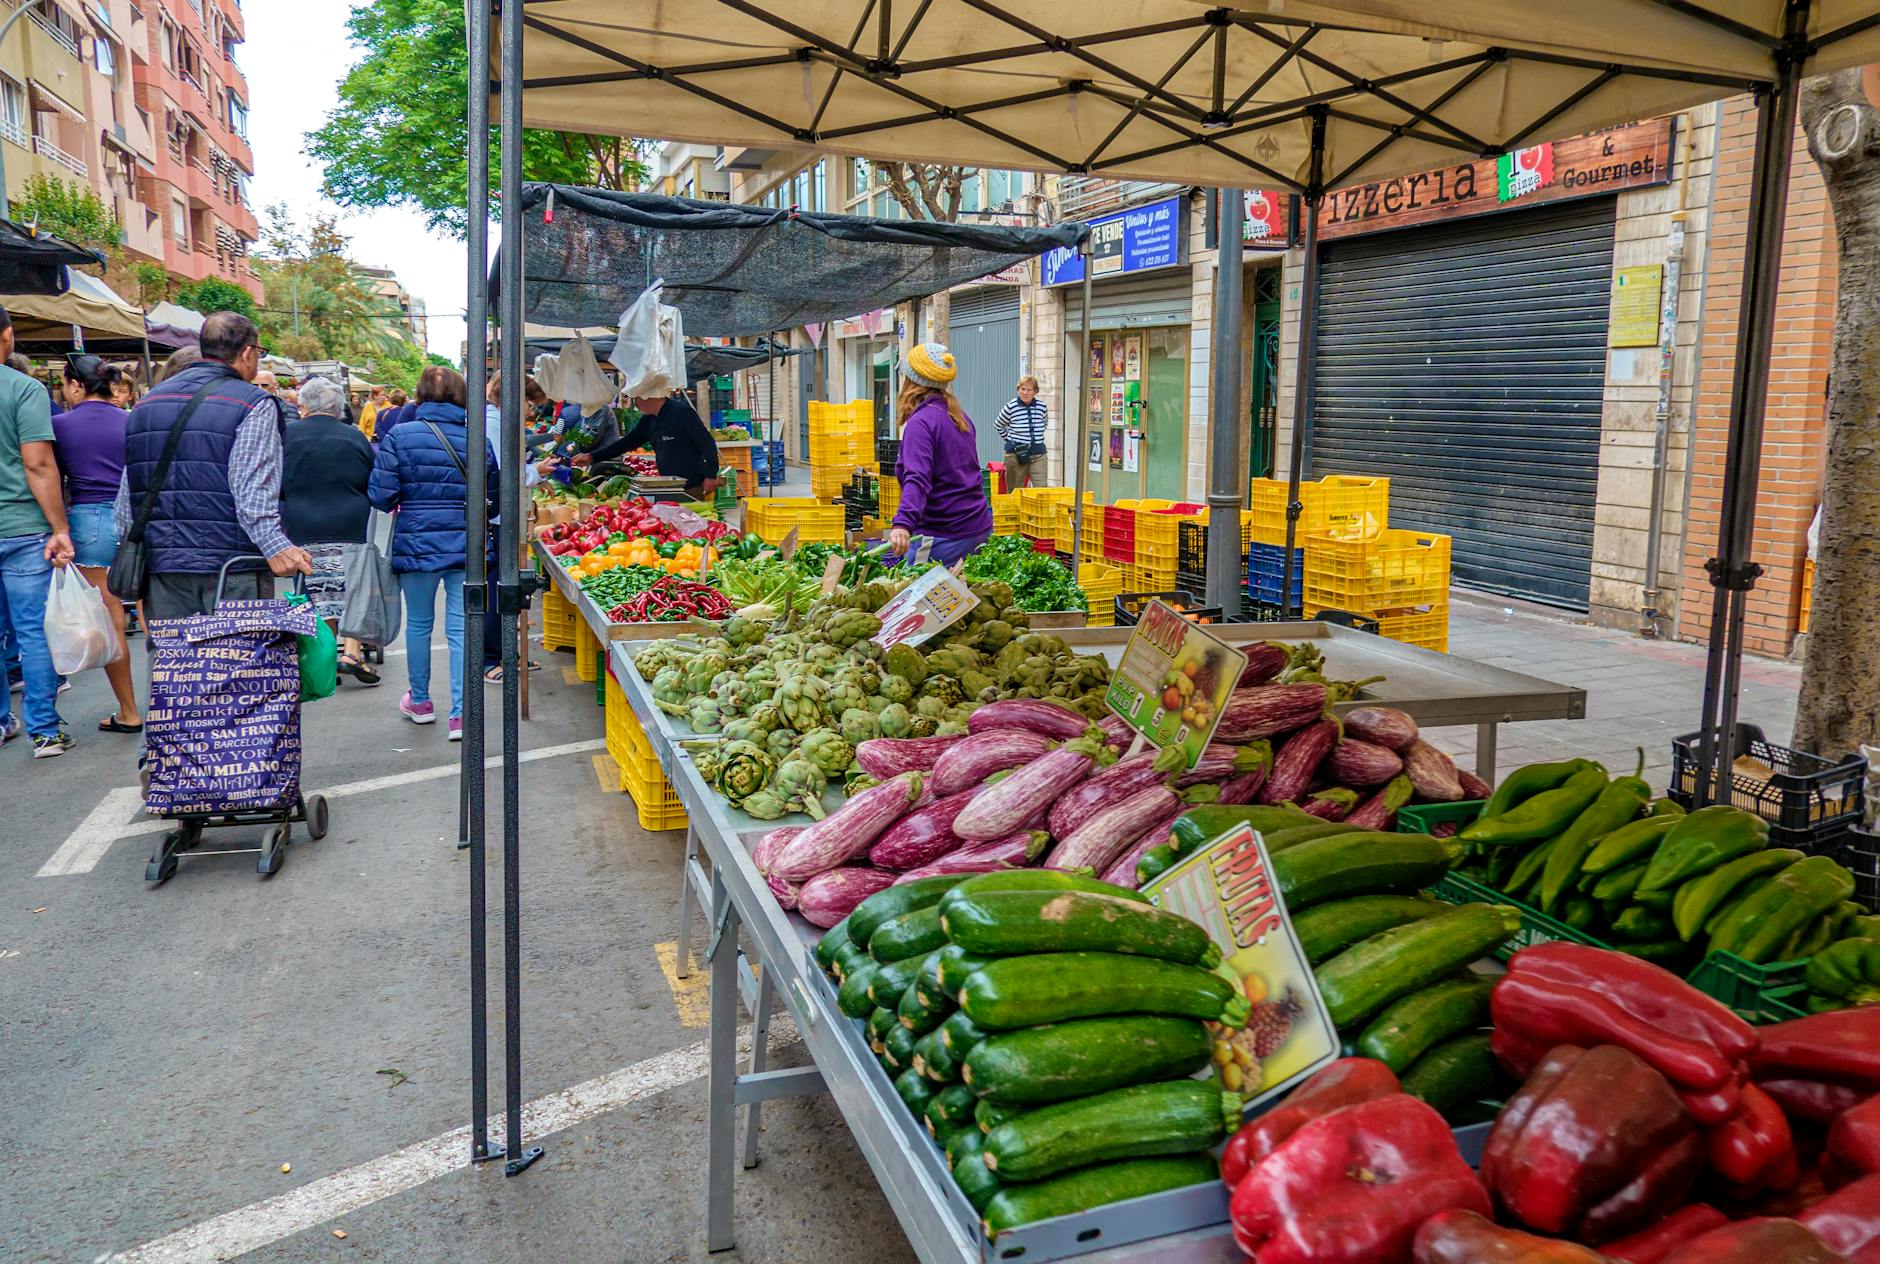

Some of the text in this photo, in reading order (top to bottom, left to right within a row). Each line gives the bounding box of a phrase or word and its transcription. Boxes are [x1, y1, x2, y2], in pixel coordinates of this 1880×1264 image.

[1602, 135, 1615, 158] &
[1563, 154, 1655, 188] Gourmet
[1510, 173, 1541, 195] pizza
[1155, 204, 1170, 221] más
[1102, 220, 1124, 242] VENDE
[190, 620, 230, 634] miami
[155, 648, 195, 659] OSKVA
[198, 681, 261, 694] MILANO
[164, 694, 234, 707] TOKIO
[175, 706, 260, 718] frankfurt
[185, 718, 226, 728] moskva
[234, 713, 279, 725] venezia
[211, 728, 237, 740] SAN
[159, 741, 209, 755] OKIO
[213, 736, 274, 750] BARCELONA
[213, 760, 280, 777] MILANO
[227, 785, 280, 801] amsterdam
[1209, 830, 1282, 949] FRUTAS
